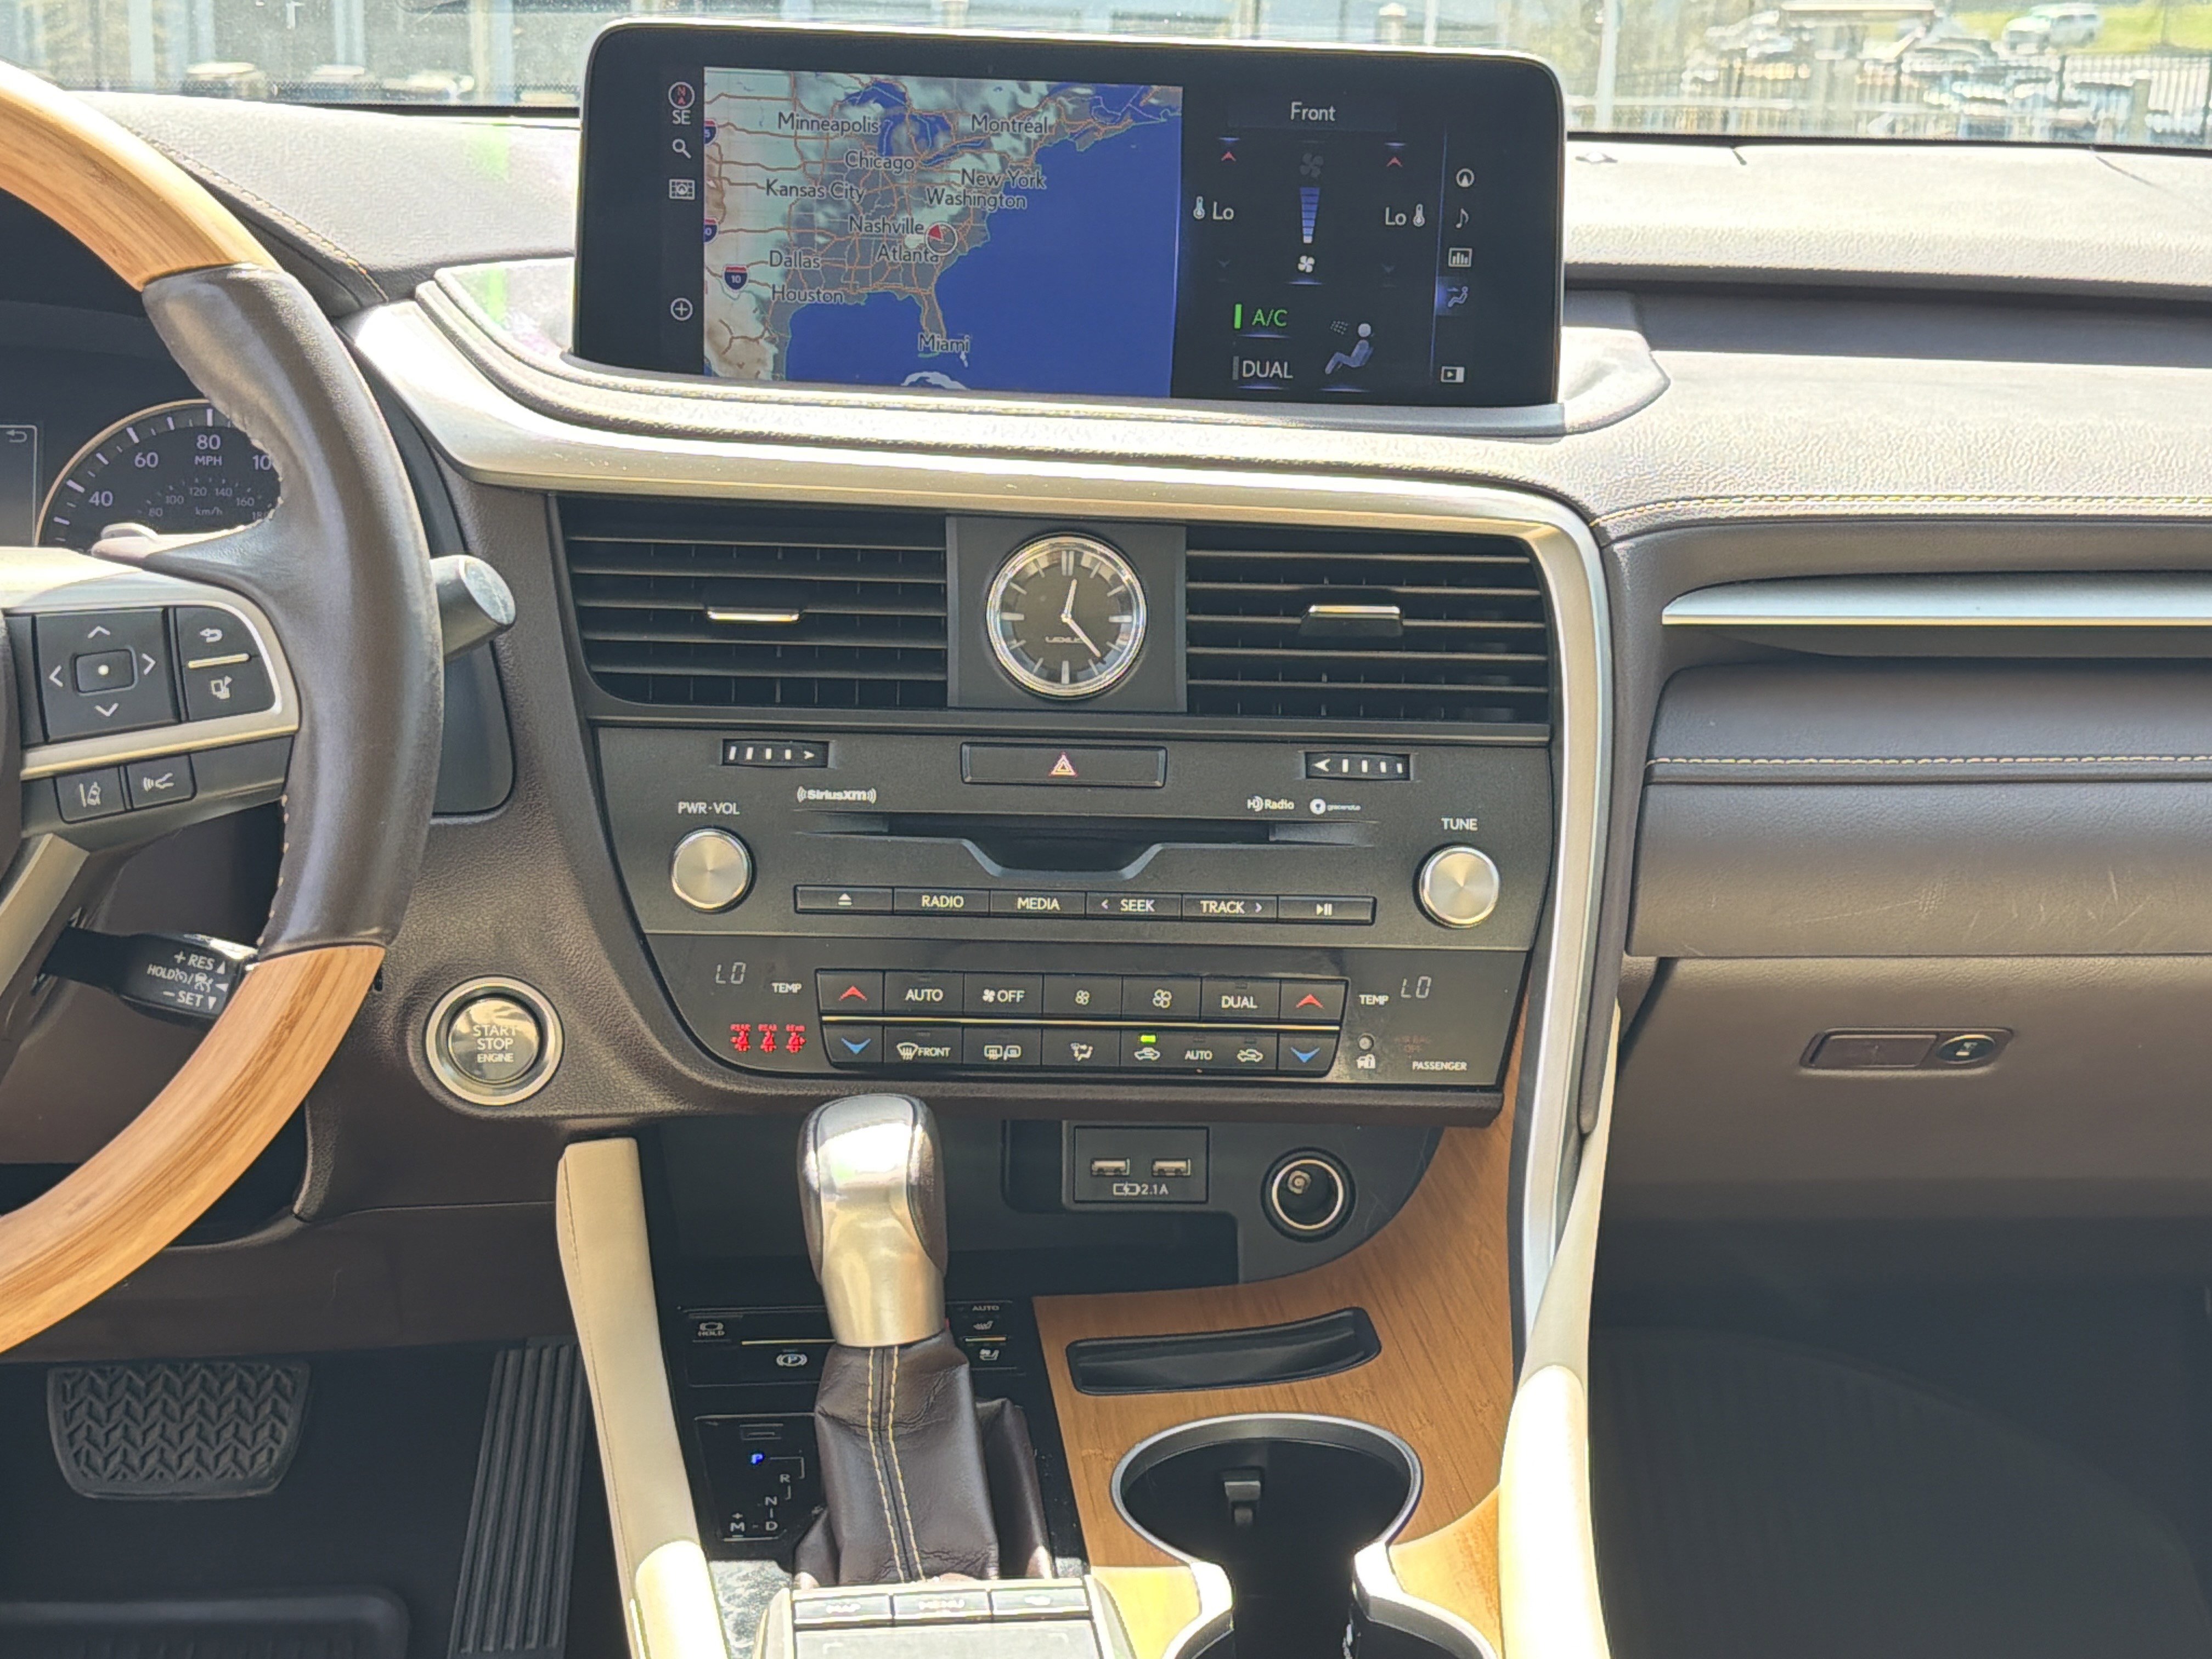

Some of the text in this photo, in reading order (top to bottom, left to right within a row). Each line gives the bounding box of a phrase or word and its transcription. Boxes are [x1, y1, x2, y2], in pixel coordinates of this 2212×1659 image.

[672, 110, 691, 125] SE
[1290, 102, 1335, 121] Front
[777, 112, 879, 135] Minneapolis
[972, 114, 1048, 134] Montréal
[845, 150, 915, 173] Chicago
[961, 168, 1046, 189] New York
[766, 179, 865, 202] Kansas City
[927, 188, 1026, 212] Washington
[1212, 202, 1234, 221] Lo
[1385, 207, 1407, 225] Lo
[849, 216, 925, 235] Nashville
[769, 251, 821, 269] Dallas
[877, 244, 939, 263] Atlanta
[731, 275, 741, 284] 10
[771, 285, 843, 303] Houston
[1251, 309, 1288, 327] A/C
[917, 334, 970, 353] Miami
[1242, 360, 1293, 379] DUAL
[196, 435, 221, 450] 80
[134, 453, 159, 469] 60
[195, 455, 222, 466] MPH
[252, 455, 272, 470] 10
[89, 491, 113, 507] 40
[190, 487, 207, 496] 120
[216, 488, 233, 496] 140
[166, 495, 184, 504] 100
[236, 497, 255, 507] 160
[148, 508, 163, 517] 80
[195, 507, 223, 516] km/h
[1265, 799, 1295, 810] Radio
[1441, 817, 1479, 831] TUNE
[922, 894, 964, 909] RADIO
[1017, 896, 1060, 911] MEDIA
[1120, 898, 1155, 912] SEEK
[1200, 900, 1245, 915] TRACK
[187, 953, 215, 970] RES
[146, 964, 175, 980] HOLD
[715, 962, 746, 985] LO
[771, 982, 802, 994] TEMP
[1401, 976, 1432, 999] LO
[177, 990, 204, 1007] SET
[905, 989, 944, 1002] AUTO
[997, 990, 1025, 1003] OFF
[1221, 995, 1257, 1009] DUAL
[1359, 994, 1390, 1006] TEMP
[472, 1024, 517, 1037] START
[477, 1037, 514, 1051] STOP
[477, 1052, 514, 1064] ENGINE
[918, 1047, 951, 1058] FRONT
[1184, 1050, 1213, 1061] AUTO
[1412, 1060, 1468, 1071] PASSENGER
[1141, 1183, 1169, 1196] 2.1A
[751, 1454, 764, 1464] P
[780, 1474, 791, 1483] R
[765, 1496, 777, 1506] N
[730, 1521, 778, 1532] M D
